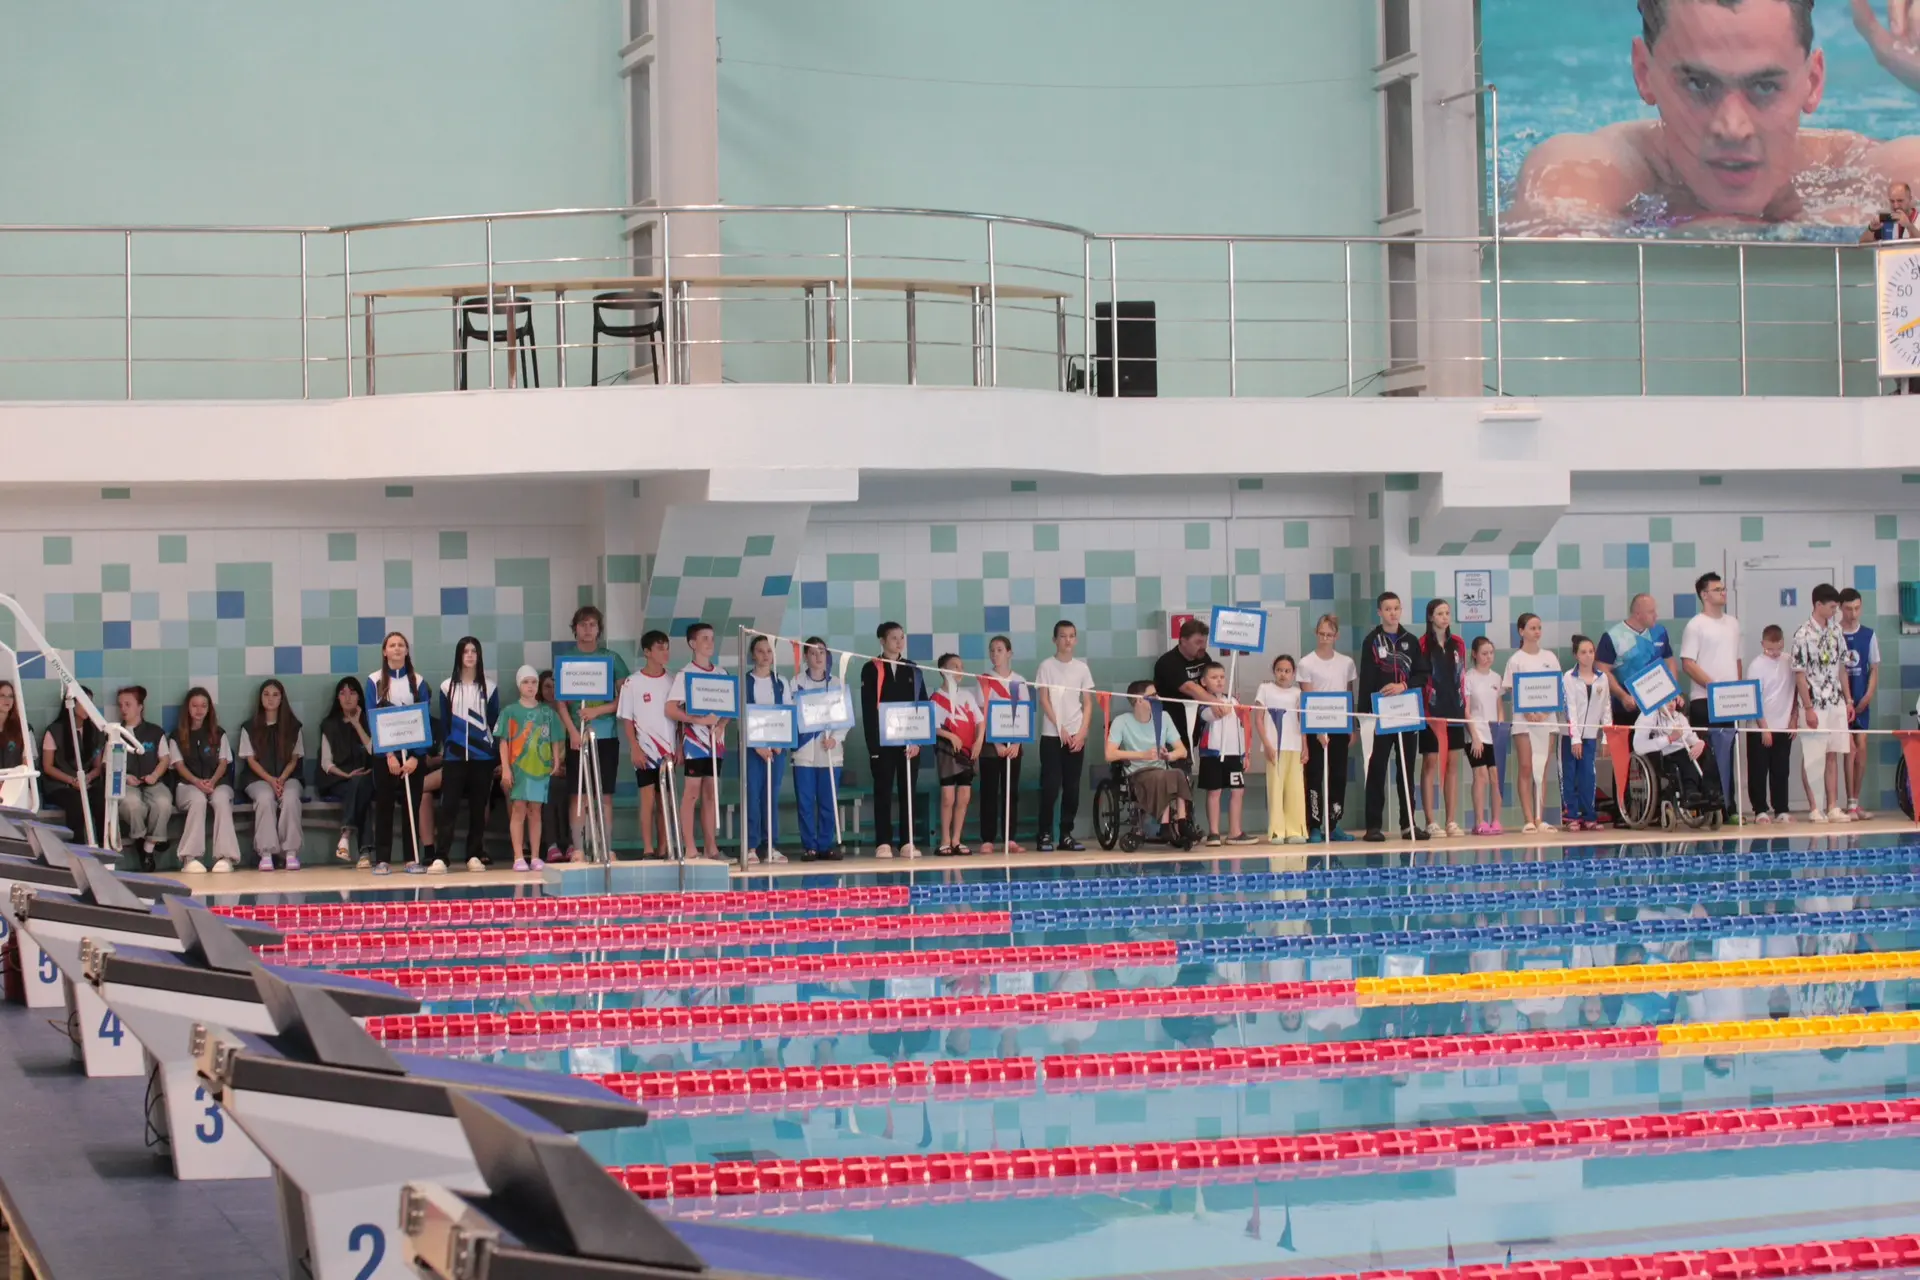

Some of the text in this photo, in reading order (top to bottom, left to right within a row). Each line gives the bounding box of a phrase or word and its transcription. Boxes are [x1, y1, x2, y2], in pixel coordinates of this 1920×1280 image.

[1896, 284, 1913, 297] 50
[1891, 306, 1908, 318] 45
[39, 947, 59, 984] 5
[98, 1007, 124, 1047] 4
[195, 1085, 224, 1144] 3
[348, 1222, 387, 1280] 2
